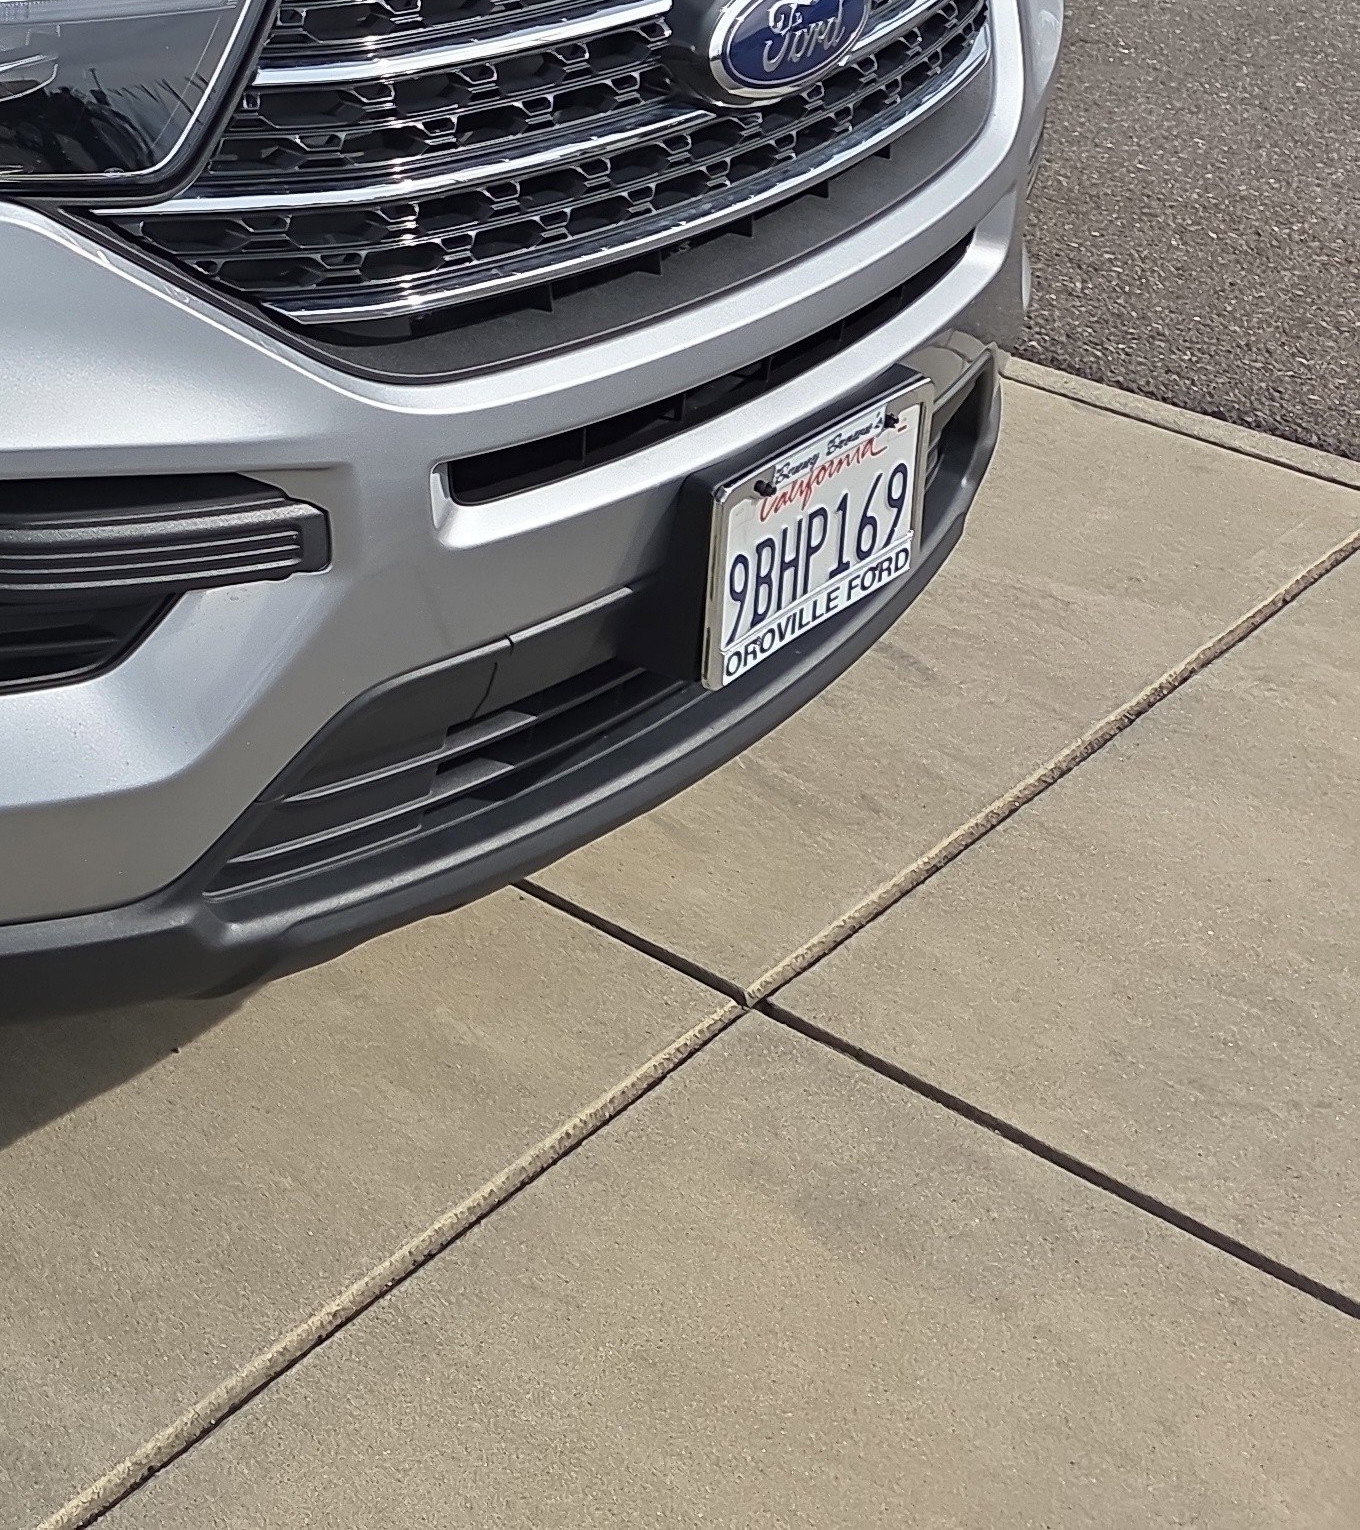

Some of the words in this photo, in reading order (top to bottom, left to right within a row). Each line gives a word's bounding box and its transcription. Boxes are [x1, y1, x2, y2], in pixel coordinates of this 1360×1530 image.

[759, 436, 888, 523] California
[725, 585, 842, 677] OROVILLE
[846, 547, 910, 602] FORD
[726, 462, 909, 648] 9BHP169
